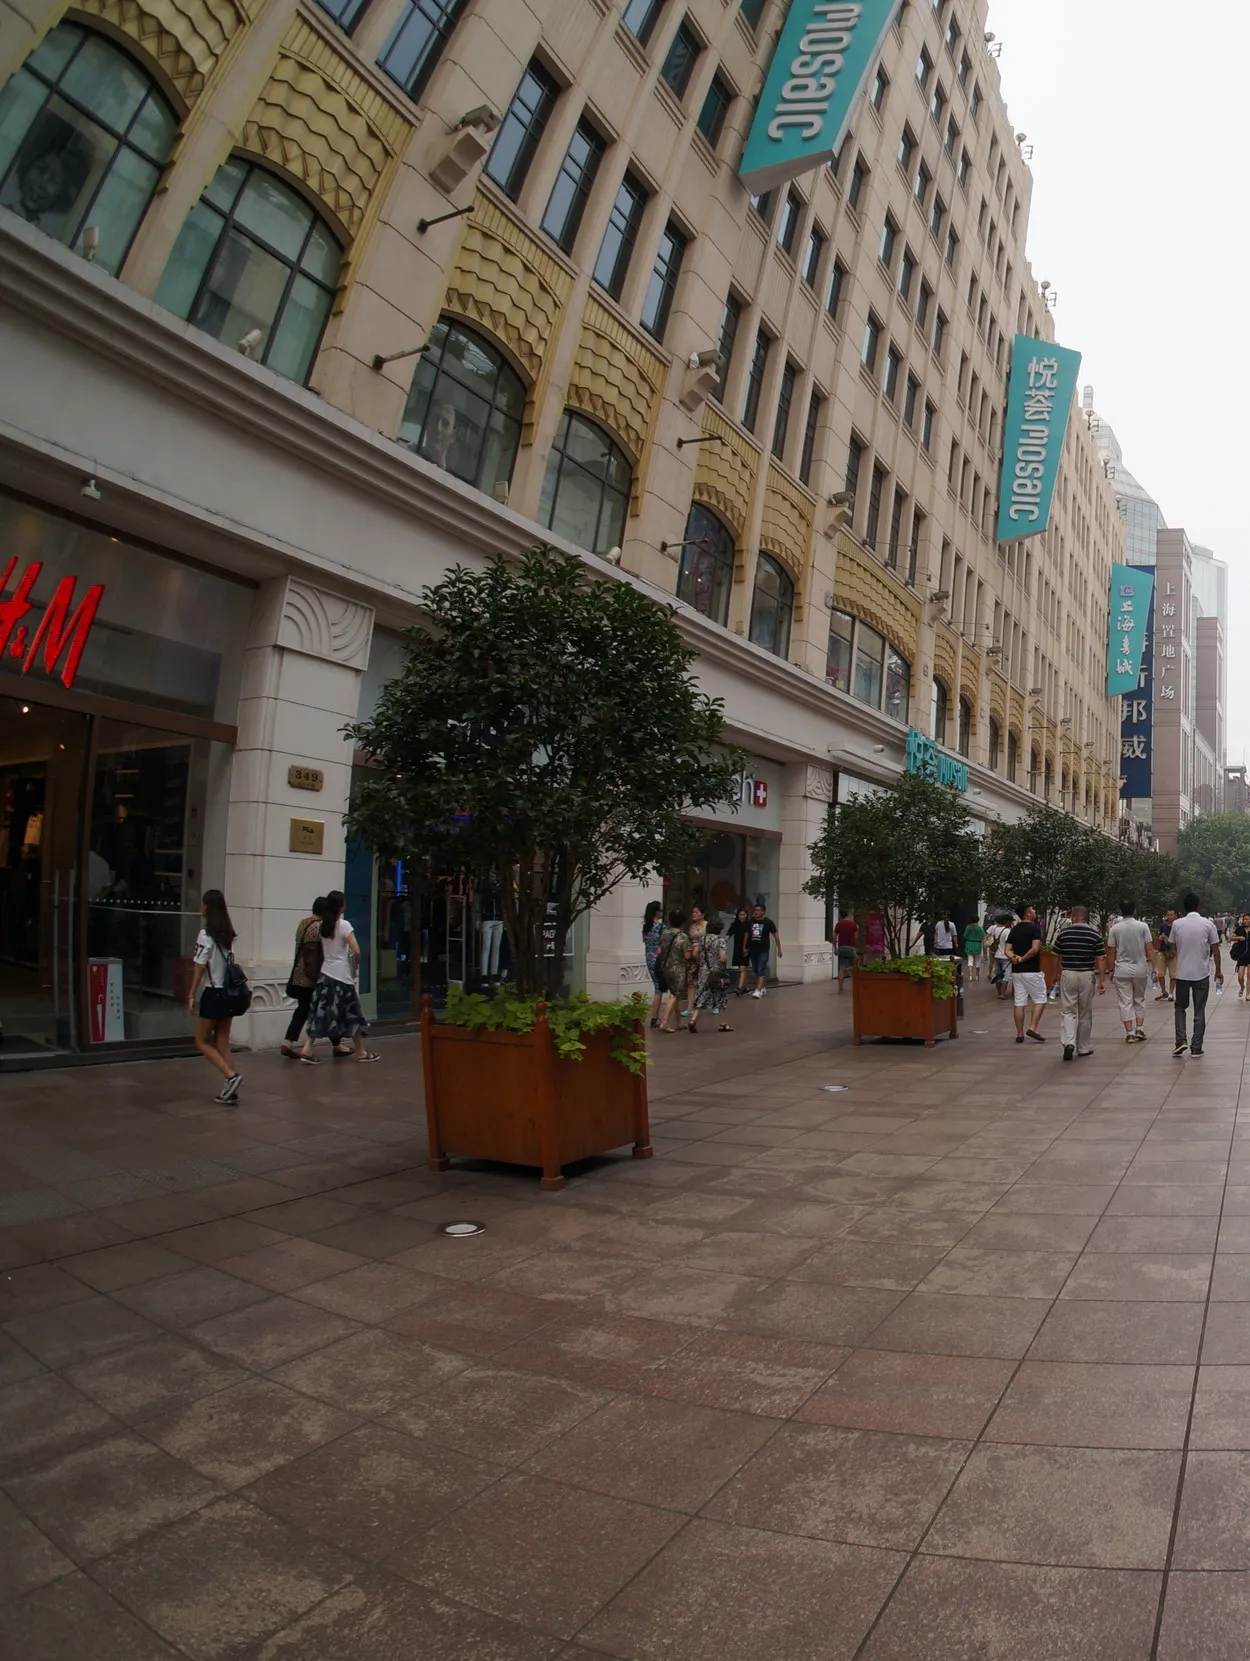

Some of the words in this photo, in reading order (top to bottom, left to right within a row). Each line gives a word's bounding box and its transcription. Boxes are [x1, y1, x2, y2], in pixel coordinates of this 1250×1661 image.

[1008, 424, 1049, 521] mosaic
[0, 556, 105, 689] H&M
[1160, 582, 1176, 700] 上海置地广场
[295, 769, 319, 782] 349
